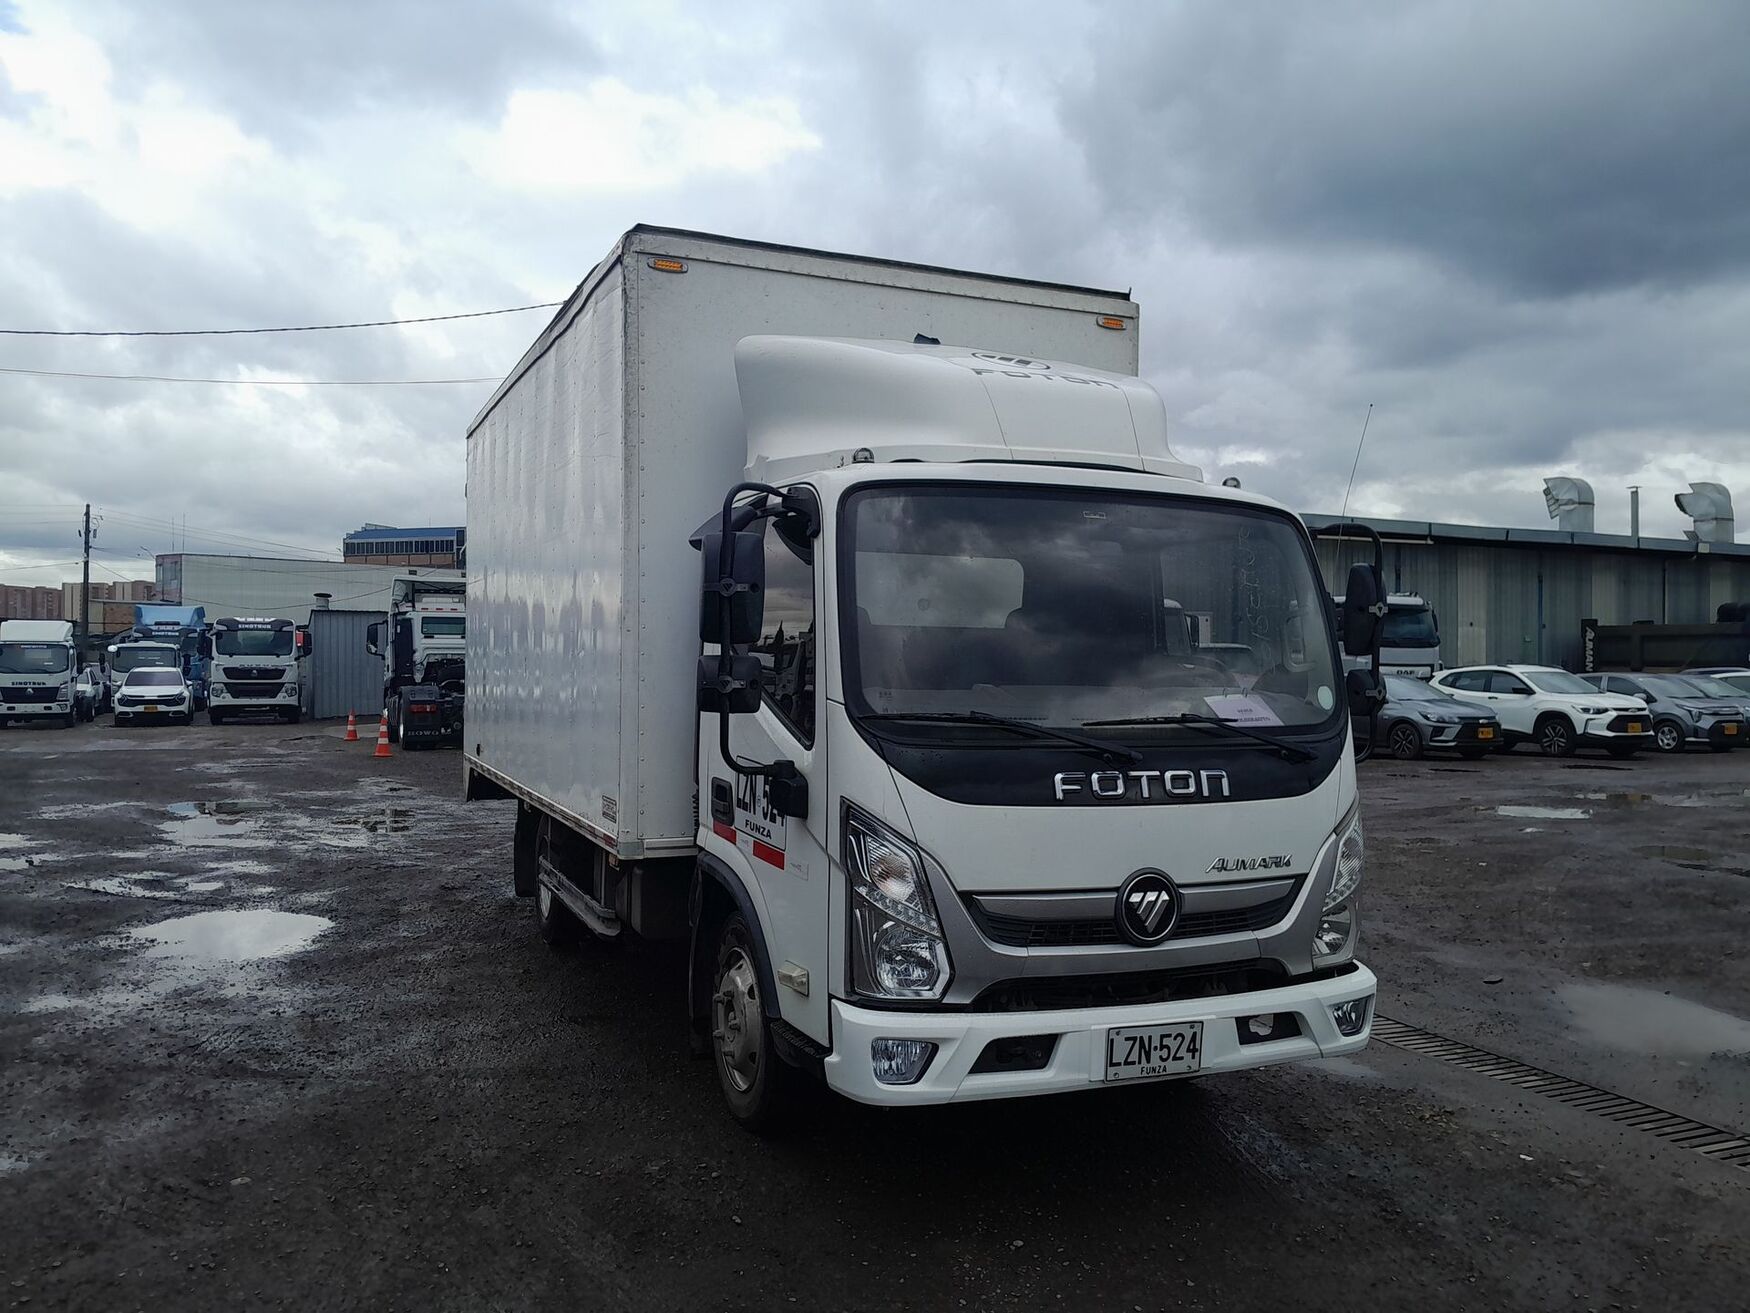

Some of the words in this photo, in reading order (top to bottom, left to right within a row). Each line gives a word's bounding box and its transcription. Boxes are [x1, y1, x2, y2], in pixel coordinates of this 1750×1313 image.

[971, 368, 1118, 389] FOTON
[1585, 626, 1595, 672] AUMAN
[1053, 769, 1231, 801] FOTON
[744, 819, 772, 840] FUNZA
[1205, 854, 1293, 874] AUMARK
[1140, 1065, 1167, 1075] FUNZA
